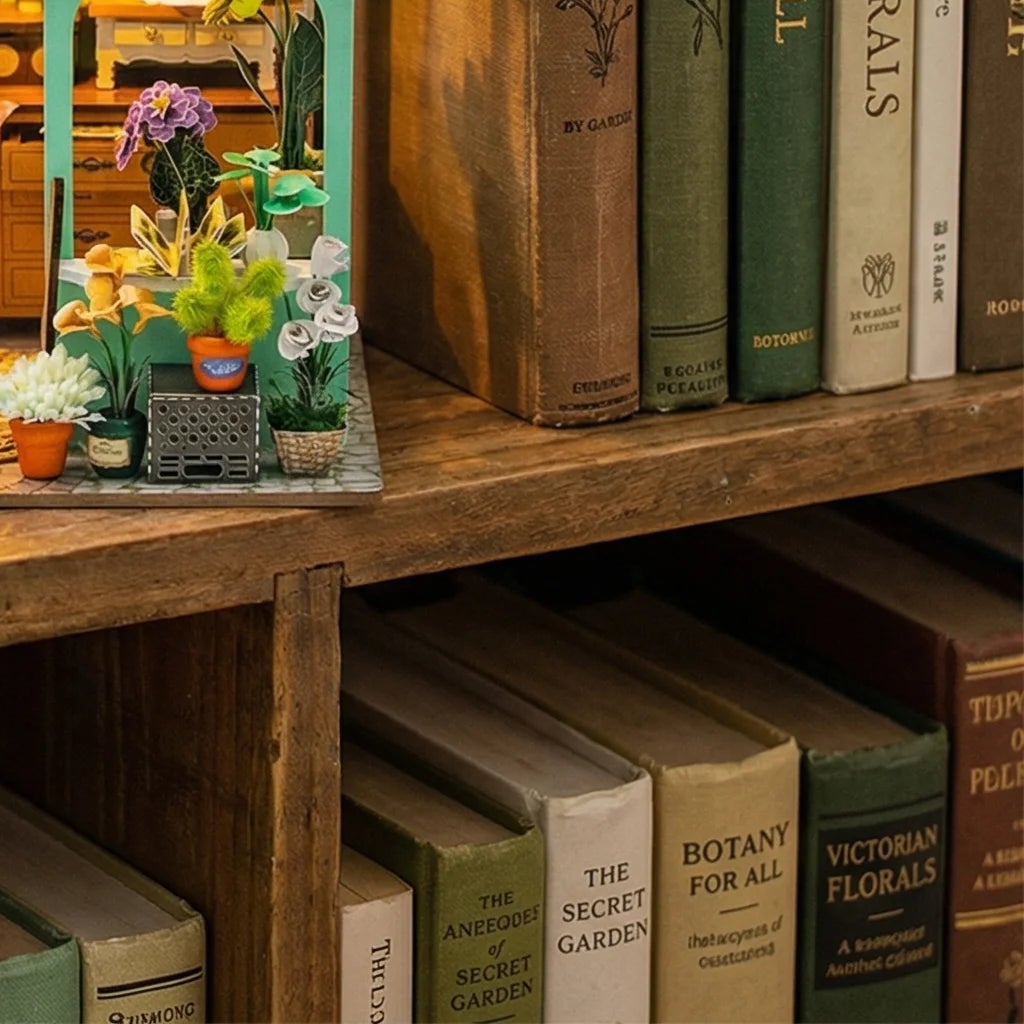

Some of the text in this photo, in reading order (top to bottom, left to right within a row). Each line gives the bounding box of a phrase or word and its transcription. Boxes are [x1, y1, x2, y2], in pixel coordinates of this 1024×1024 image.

[682, 820, 790, 866] BOTANY
[827, 824, 939, 867] VICTORIAN
[584, 862, 630, 888] THE
[689, 859, 783, 896] FOR ALL
[827, 857, 938, 903] FLORALS
[478, 891, 514, 910] THE
[562, 888, 646, 923] SECRET
[488, 939, 506, 958] of
[557, 918, 649, 955] GARDEN
[456, 955, 532, 986] SECRET
[450, 978, 534, 1012] GARDEN
